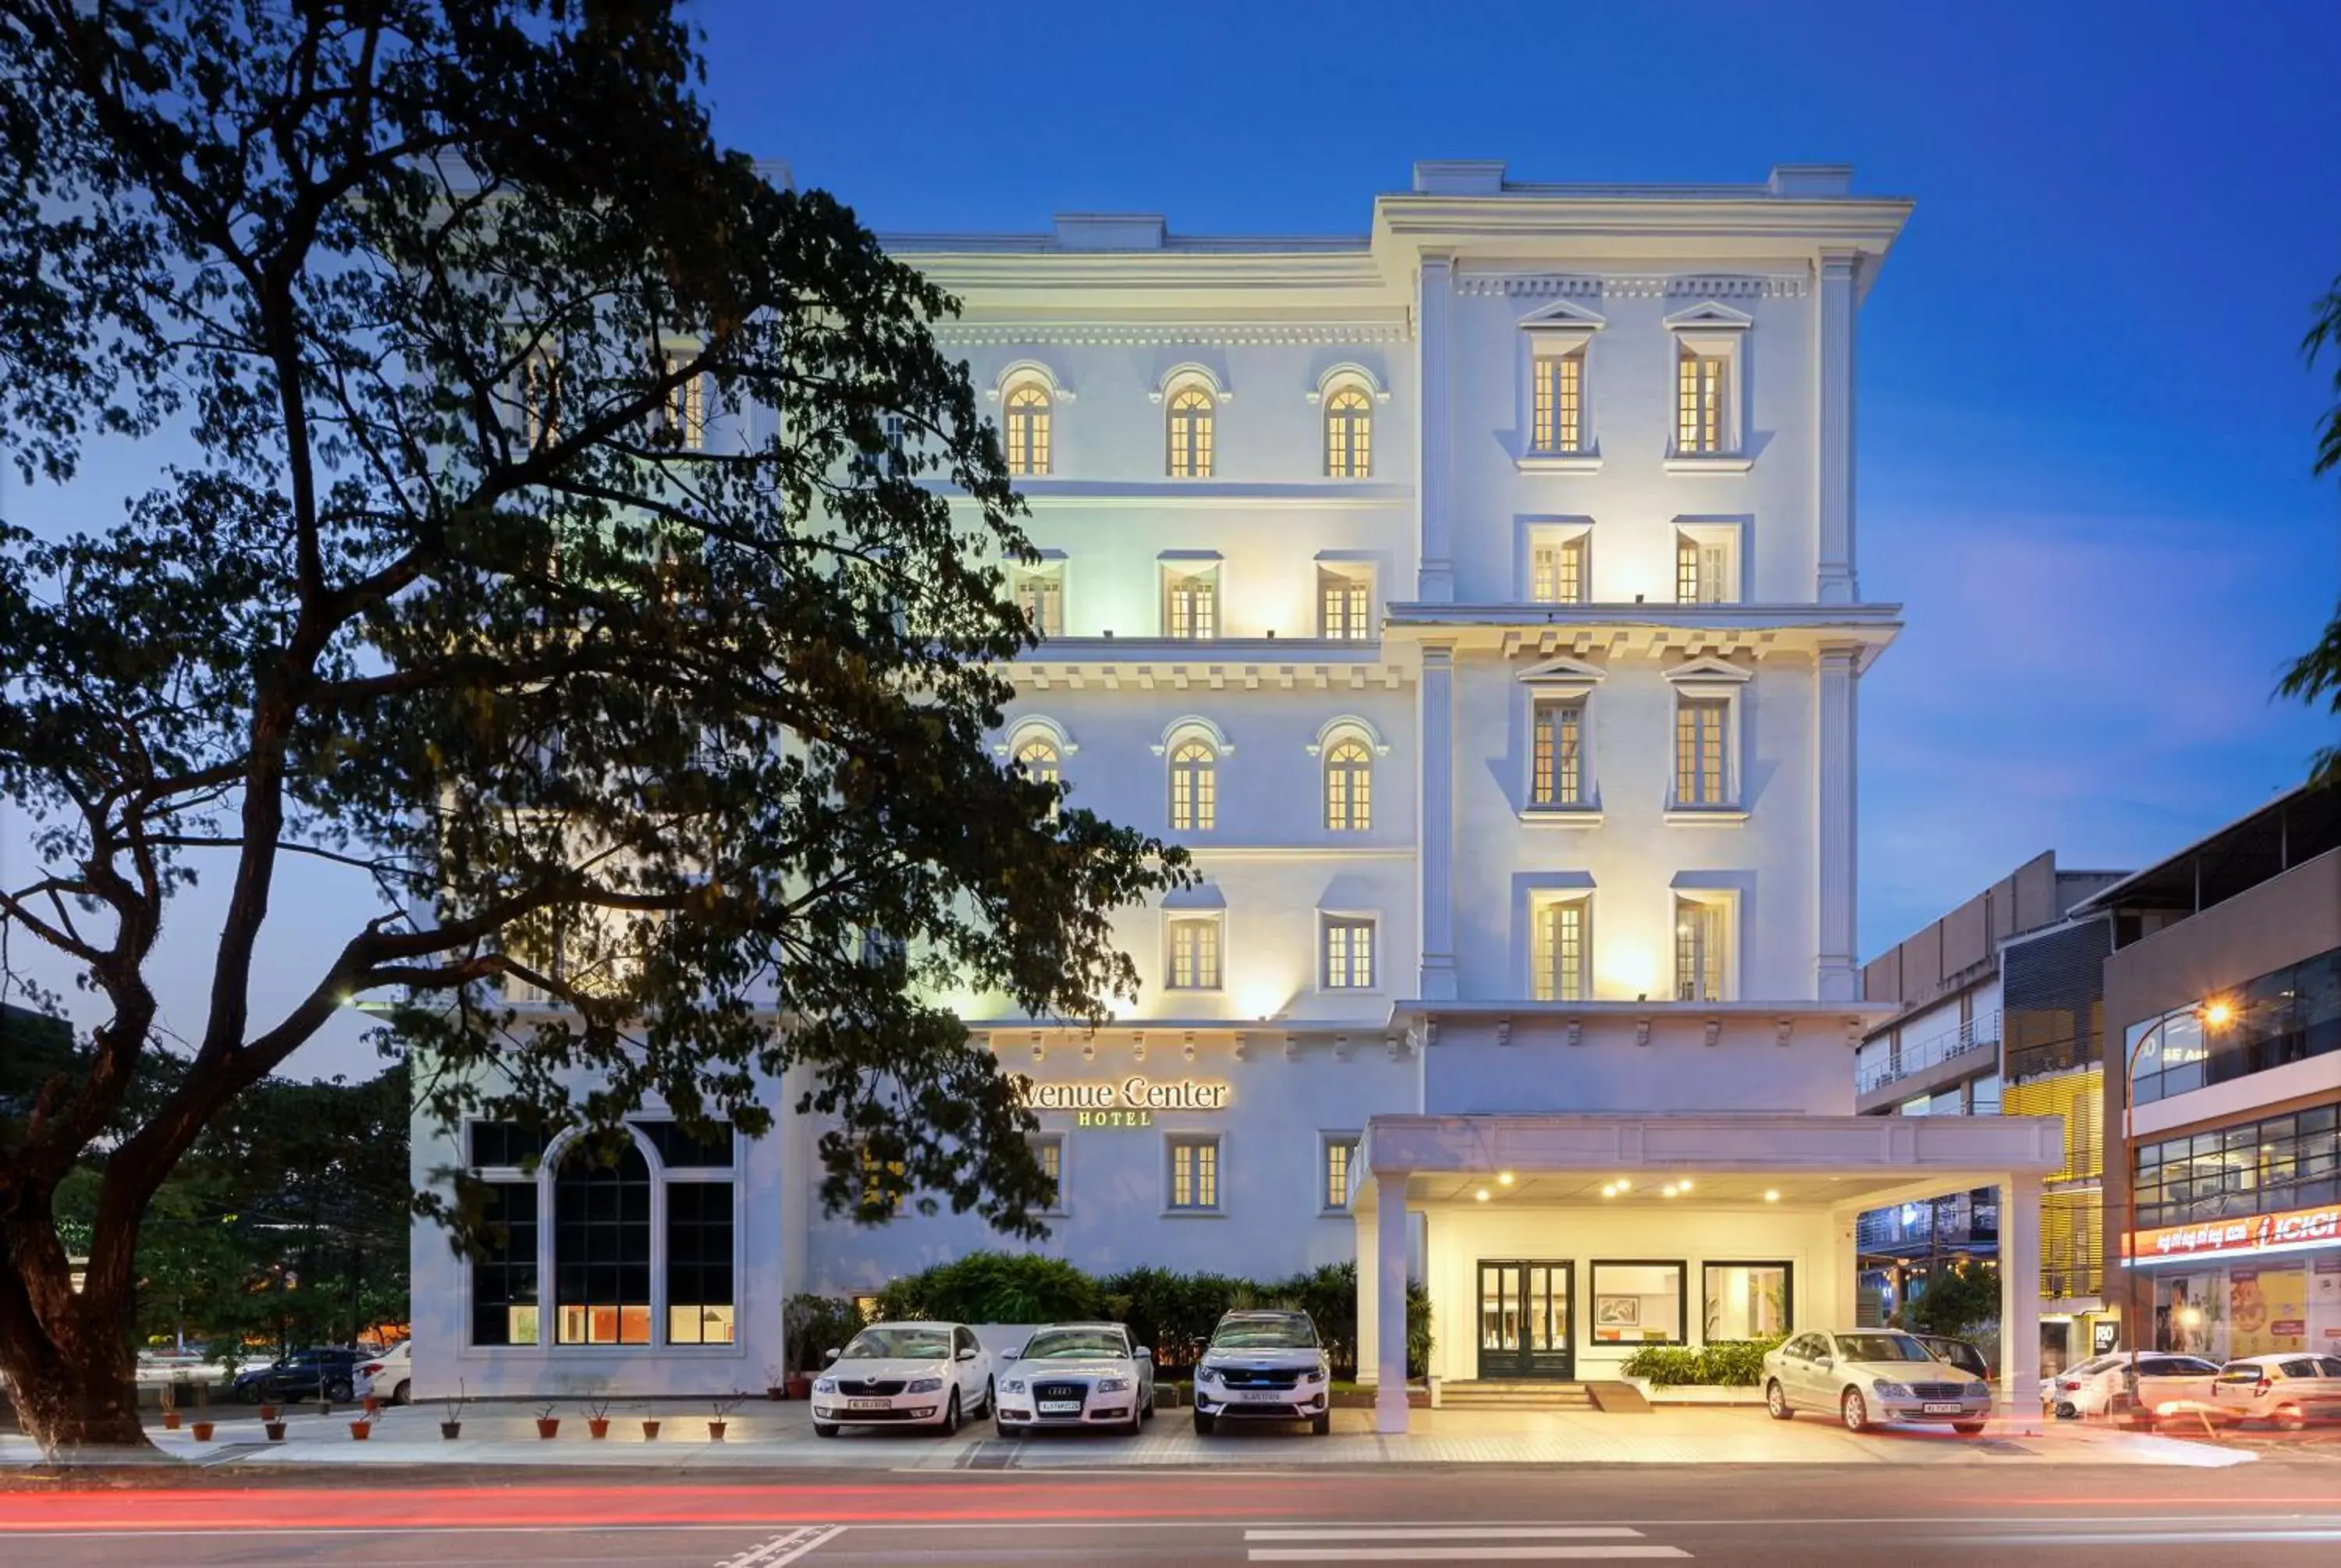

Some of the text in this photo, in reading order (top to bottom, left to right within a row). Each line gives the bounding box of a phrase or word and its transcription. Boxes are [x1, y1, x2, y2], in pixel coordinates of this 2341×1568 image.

[1007, 1075, 1226, 1107] venue Center
[1079, 1112, 1151, 1126] HOTEL
[2274, 1211, 2338, 1240] ICICI
